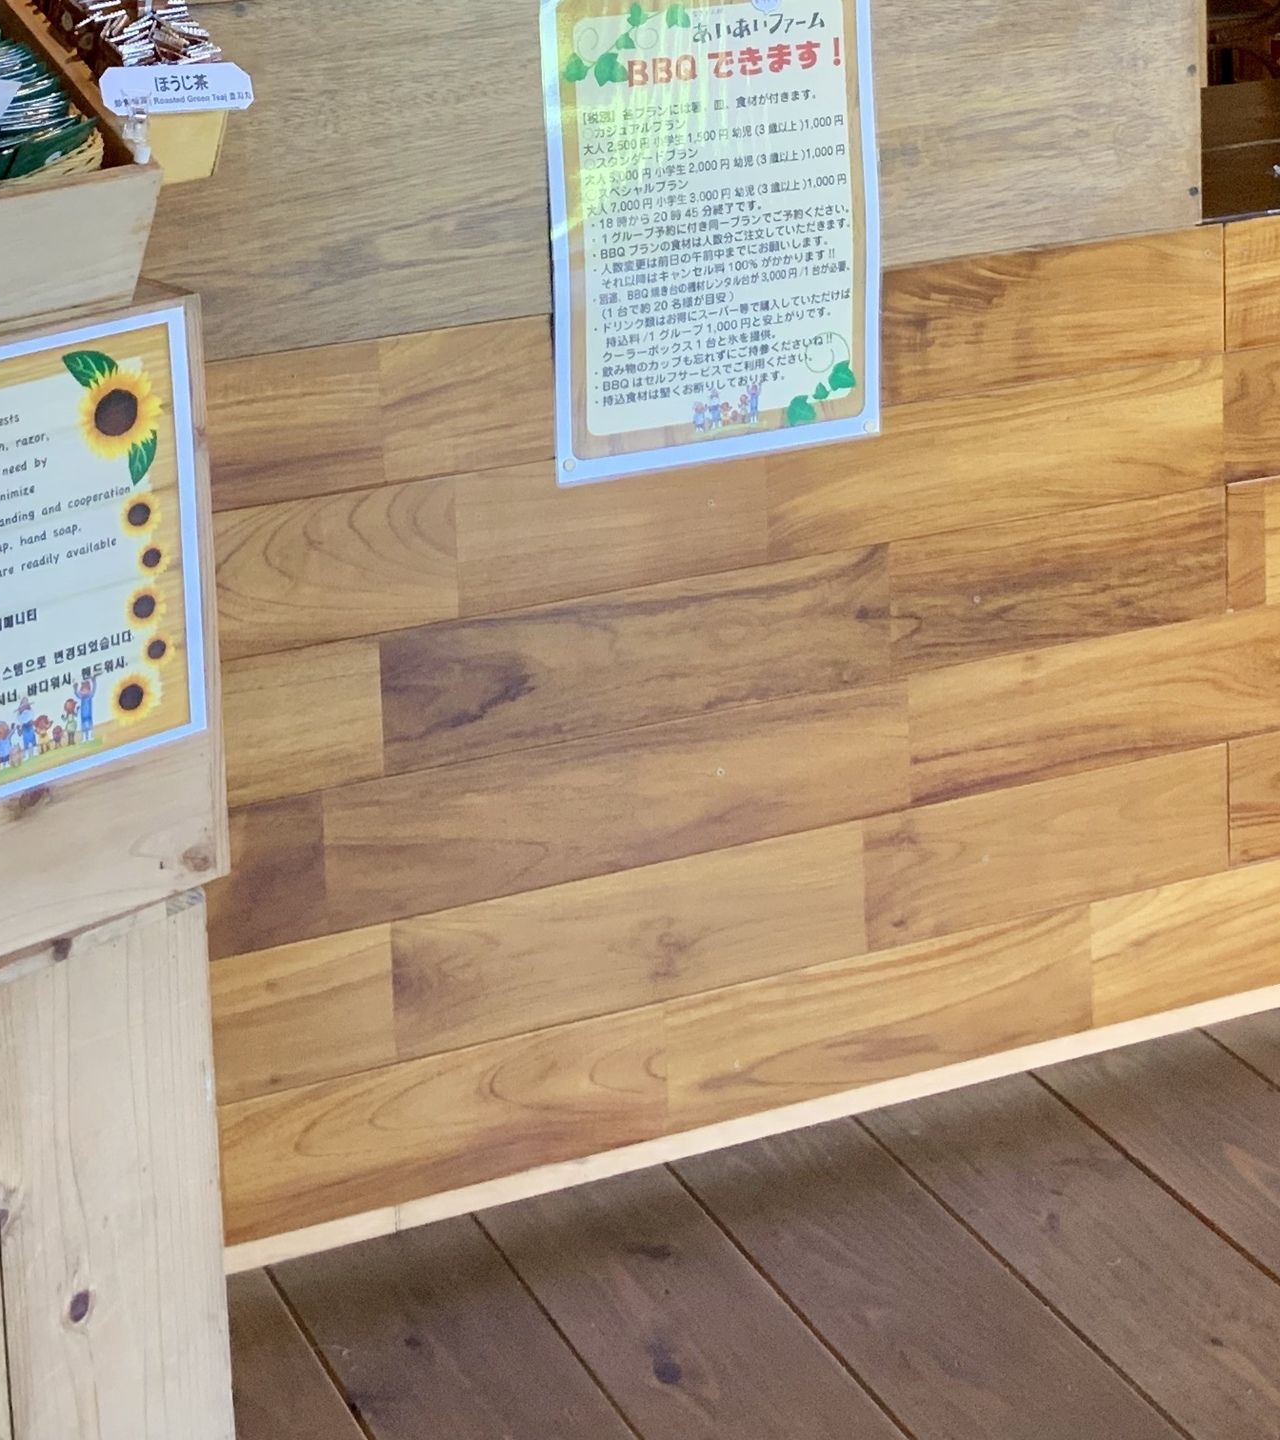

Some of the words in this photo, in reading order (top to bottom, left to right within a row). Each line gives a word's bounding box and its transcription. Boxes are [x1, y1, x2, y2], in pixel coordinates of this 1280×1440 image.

[693, 12, 825, 44] あいあいファーム
[626, 53, 697, 87] BBQ
[154, 73, 210, 92] ほうじ茶
[187, 94, 211, 103] Green
[2, 460, 27, 476] need
[34, 457, 47, 468] by
